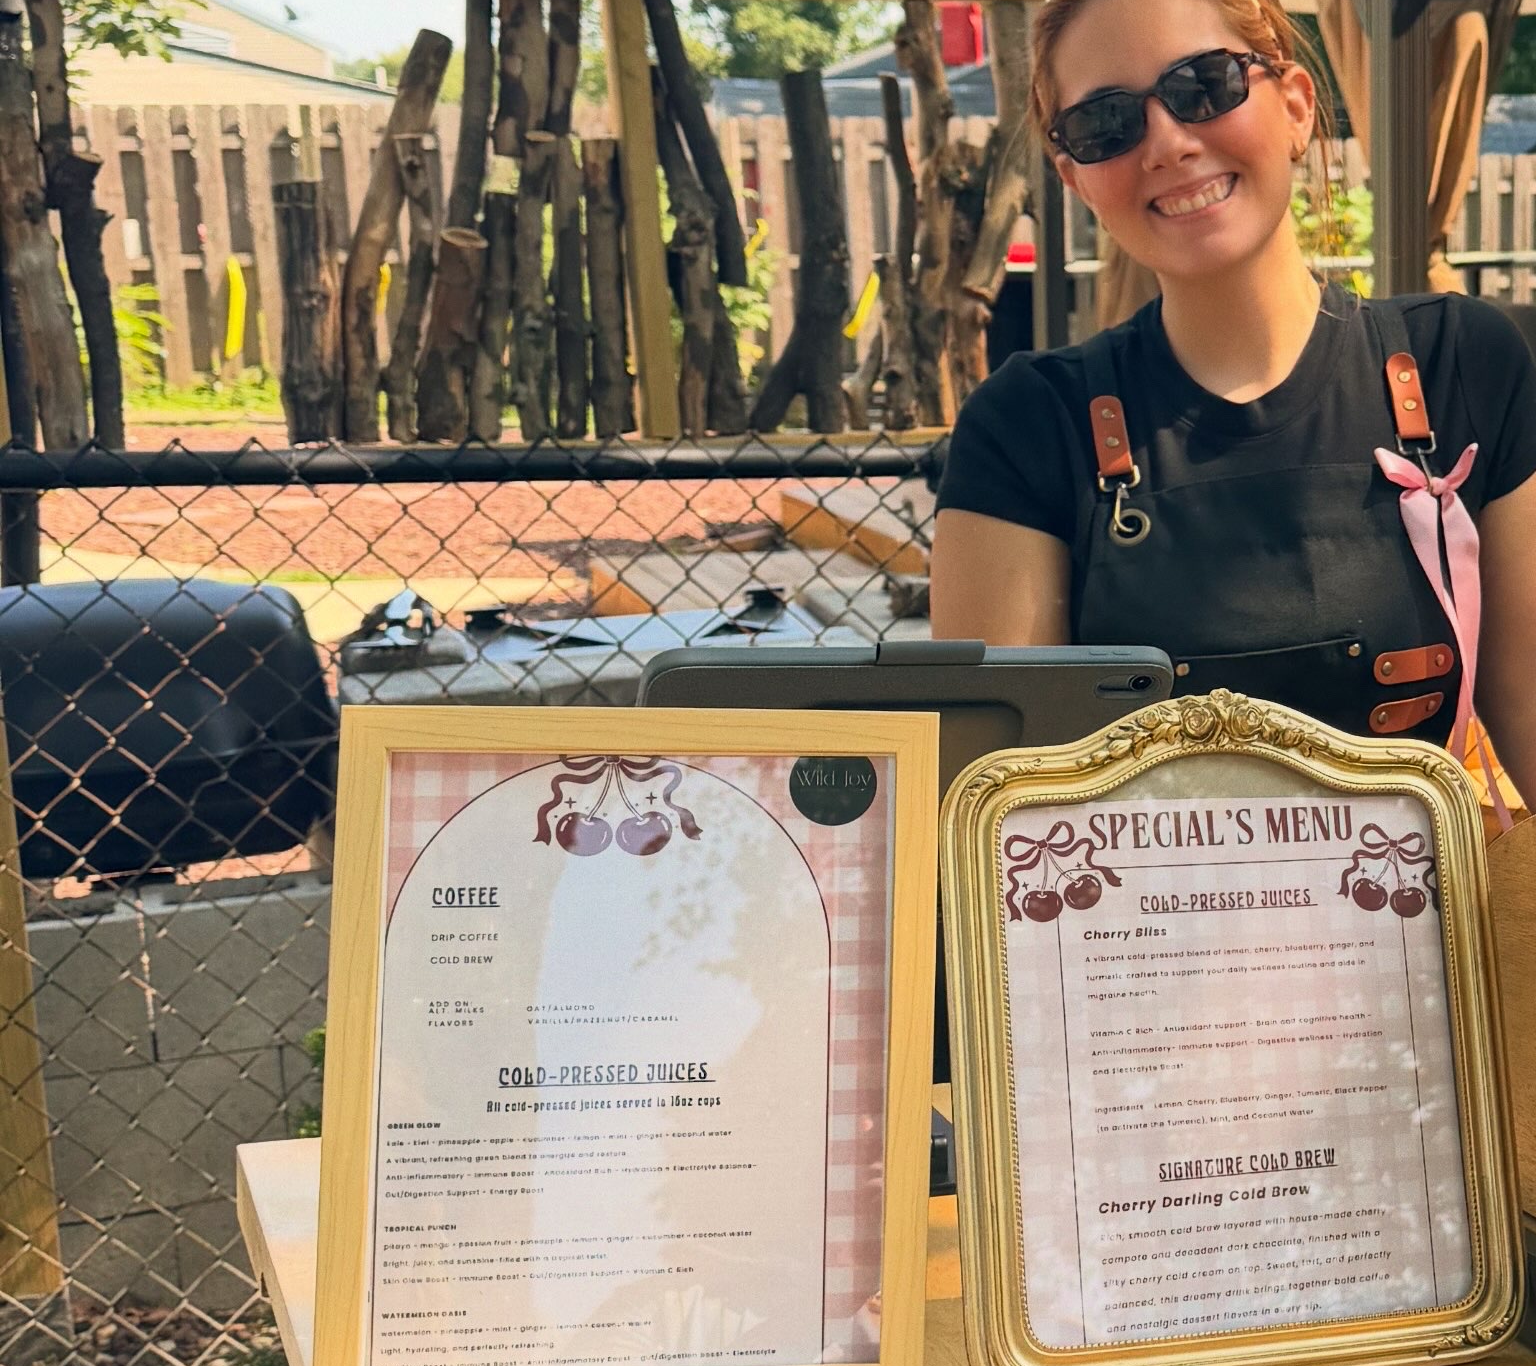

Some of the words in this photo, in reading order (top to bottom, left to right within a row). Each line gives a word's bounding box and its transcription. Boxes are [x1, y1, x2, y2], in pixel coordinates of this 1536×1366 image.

[796, 769, 835, 786] Wild
[844, 770, 871, 791] Joy
[1088, 808, 1254, 850] SPECIAL'S
[1265, 805, 1352, 843] MENU
[432, 886, 499, 906] COFFEE
[1140, 890, 1255, 912] COLD-PRESSED
[1260, 888, 1311, 907] JUICES
[431, 933, 456, 942] DRIP
[458, 932, 499, 942] COFFEE
[1083, 930, 1131, 942] Cherry
[1135, 926, 1167, 938] Bliss
[1358, 940, 1375, 948] and
[429, 955, 460, 965] COLD
[463, 955, 494, 964] BREW
[1171, 968, 1204, 977] support
[1227, 966, 1248, 974] daily
[1319, 960, 1336, 968] and
[429, 1000, 450, 1008] ADD
[428, 1019, 474, 1028] FLAVORS
[1126, 1028, 1132, 1036] C
[1135, 1027, 1154, 1035] Rich
[498, 1063, 638, 1087] COLD-PRESSED
[646, 1061, 708, 1082] JUICES
[670, 1095, 693, 1107] 16oz
[1158, 1156, 1244, 1180] SIGNATURE
[1249, 1152, 1289, 1172] COLD
[1294, 1147, 1335, 1168] BREW
[1098, 1199, 1157, 1214] Cherry
[1162, 1191, 1223, 1209] Darling
[1229, 1186, 1267, 1202] Cold
[1271, 1185, 1310, 1198] Brew
[1350, 1230, 1371, 1239] with
[1334, 1275, 1356, 1286] bold
[1261, 1308, 1271, 1316] in
